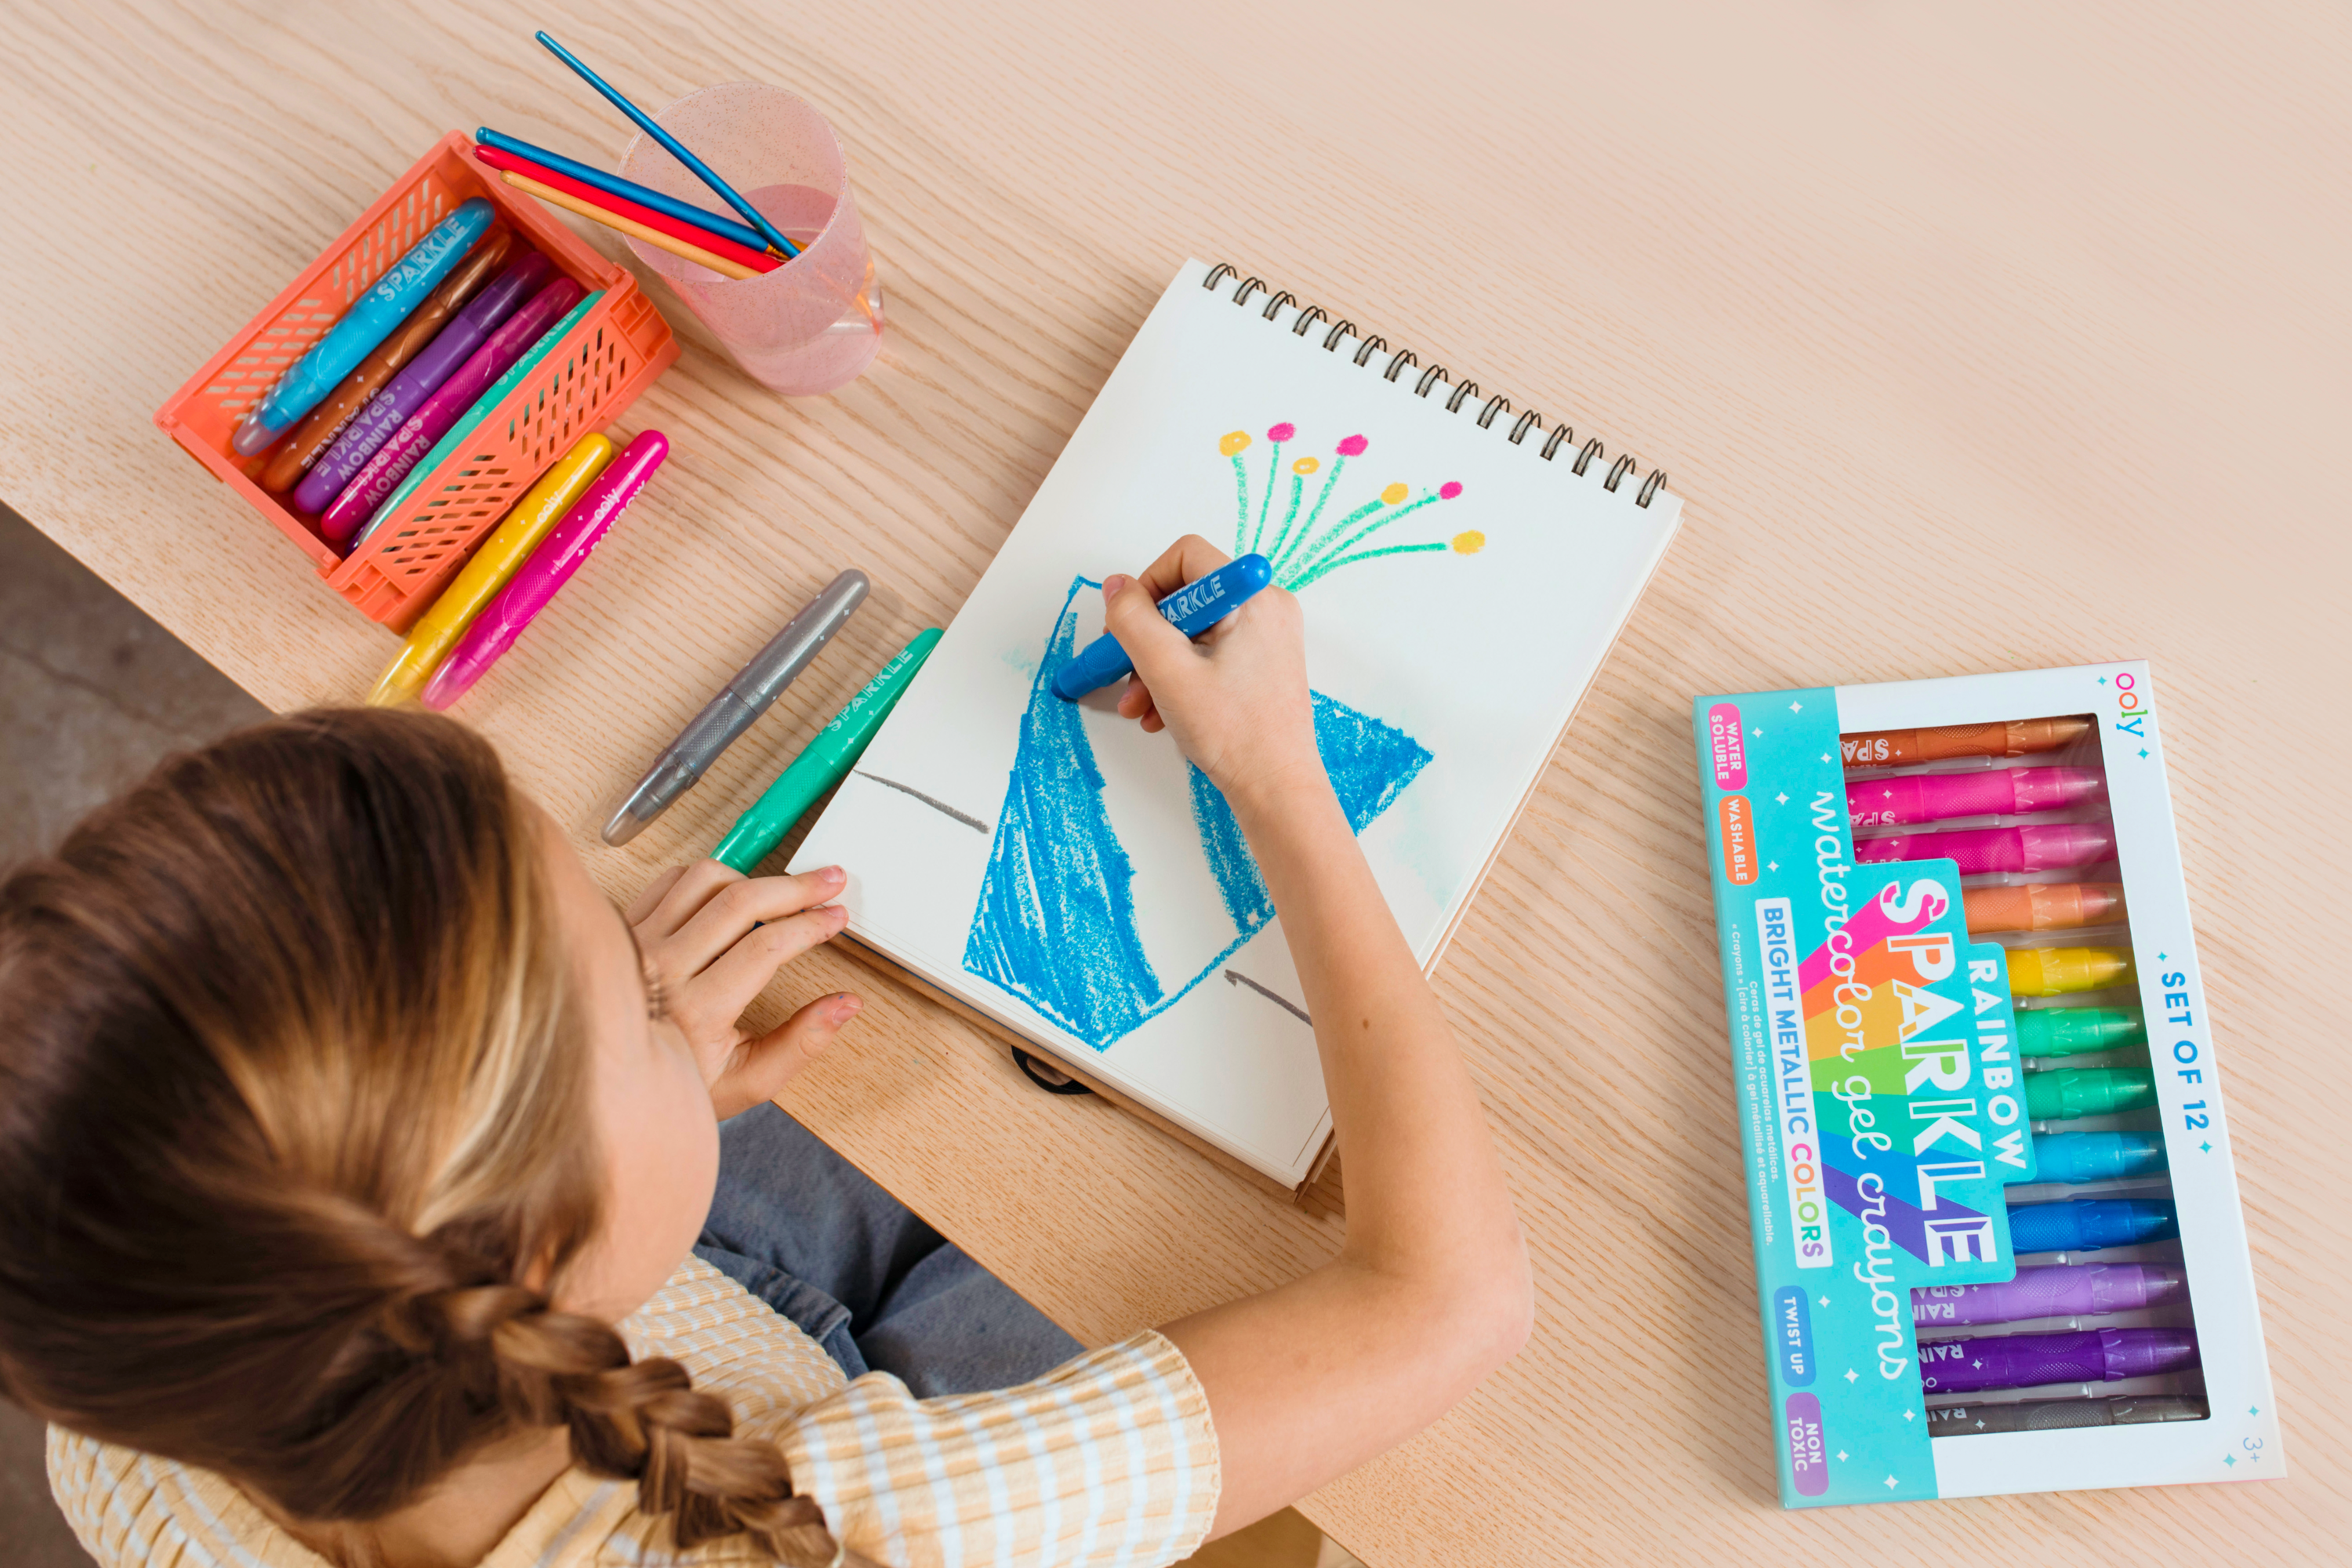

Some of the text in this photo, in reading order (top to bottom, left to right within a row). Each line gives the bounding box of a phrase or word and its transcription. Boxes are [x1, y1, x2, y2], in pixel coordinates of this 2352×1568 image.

[377, 217, 466, 302] SPARKLE
[314, 390, 395, 477] SPARKLE
[337, 409, 404, 481] RAINBOW
[341, 416, 423, 503] SPARKLE
[364, 434, 430, 507] RAINBOW
[537, 491, 562, 523] ooly
[594, 488, 620, 520] ooly
[1160, 575, 1225, 624] ARKLE
[827, 648, 913, 731] SPARKLE
[2116, 673, 2148, 738] ooly
[1711, 715, 1730, 780] SOLUBLE
[1726, 722, 1742, 771] WATER
[1727, 799, 1748, 881] WASHABLE
[1749, 982, 1779, 1183] Ceras de gel de acuarelas metálicas.
[1763, 907, 1824, 1257] BRIGHT METALLIC COLORS
[1810, 791, 1908, 1380] watercolor gel crayons
[1879, 879, 1998, 1267] SPARKLE
[1968, 960, 2027, 1169] RAINBOW
[2161, 972, 2209, 1131] SET OF 12
[1745, 1083, 1759, 1101] gel
[1751, 1103, 1763, 1155] métallisé
[1757, 1156, 1766, 1168] et
[1757, 1171, 1774, 1246] aquarellable.
[1784, 1297, 1804, 1374] TWIST UP
[1790, 1417, 1808, 1472] TOXIC
[1806, 1423, 1822, 1463] NON
[2243, 1437, 2263, 1462] 3+
